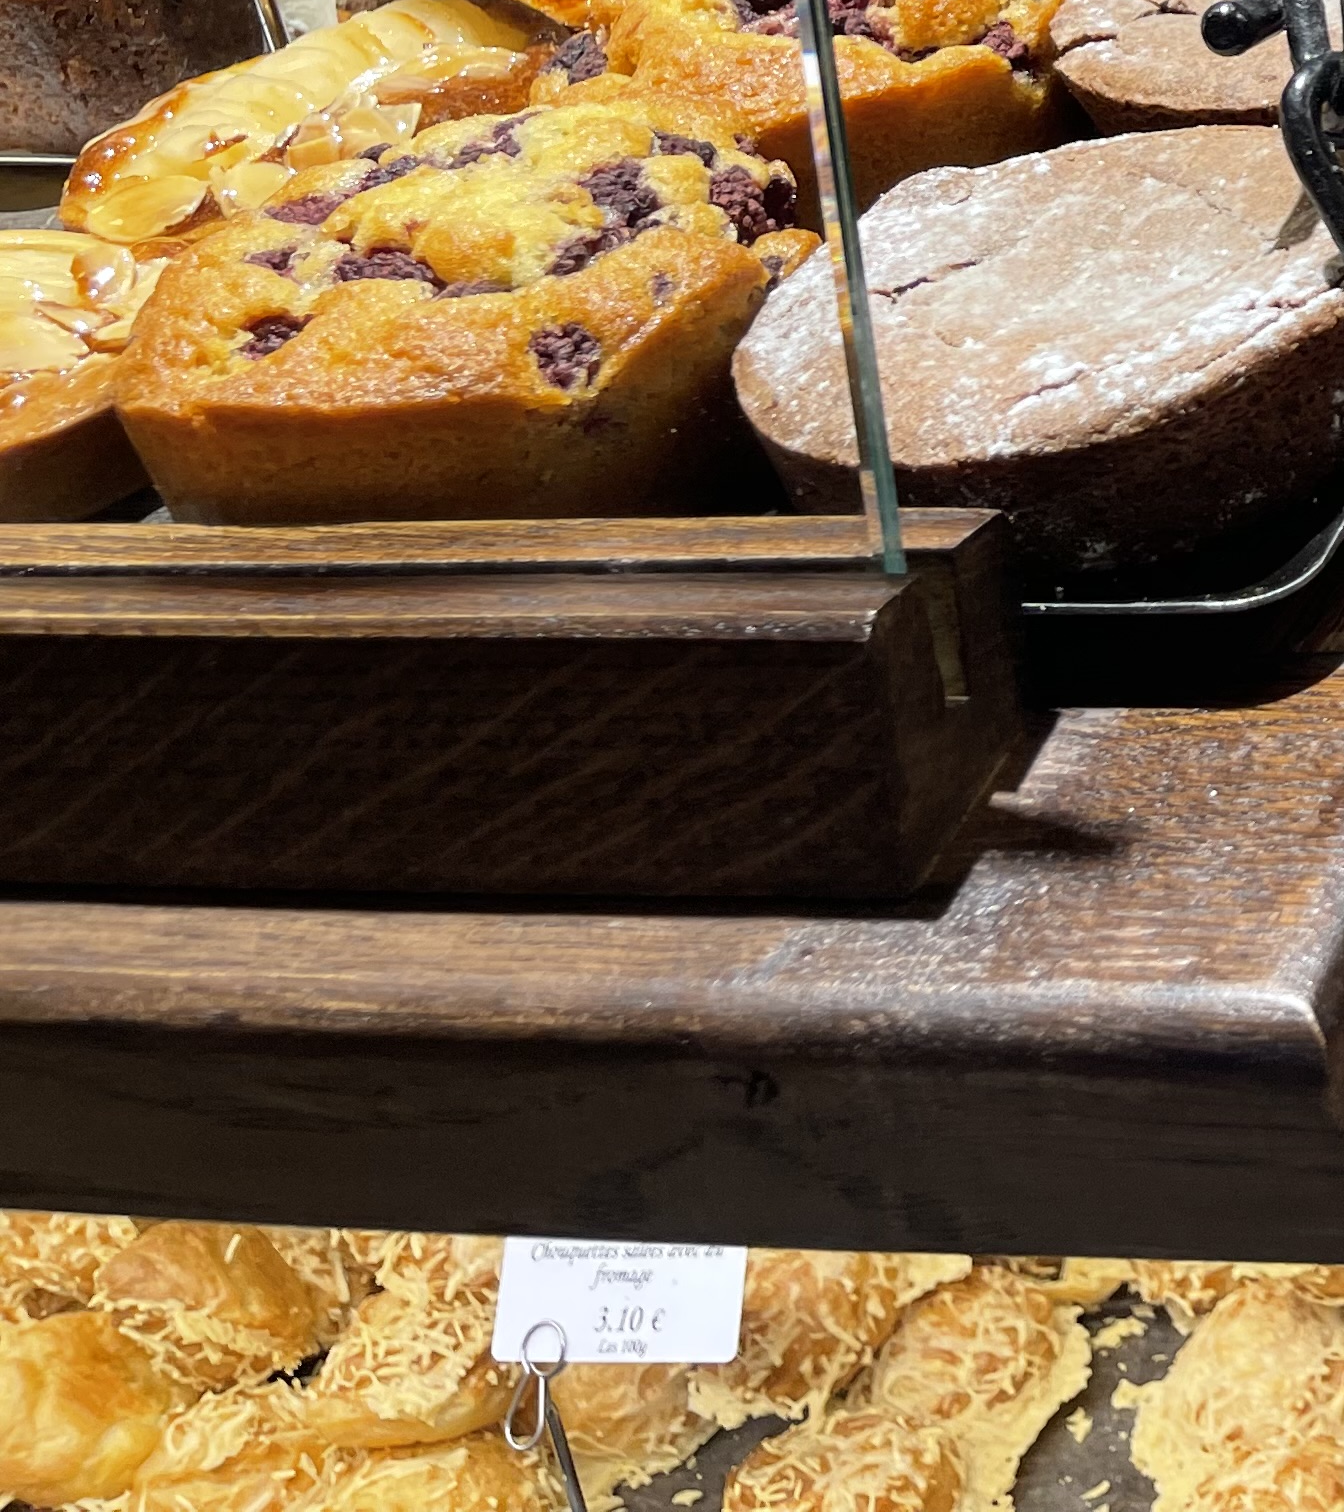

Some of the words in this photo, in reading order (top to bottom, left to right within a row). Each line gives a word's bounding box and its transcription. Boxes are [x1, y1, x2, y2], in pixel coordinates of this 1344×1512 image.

[589, 1262, 653, 1291] fromage
[594, 1305, 644, 1333] 3.10
[652, 1308, 666, 1332] €
